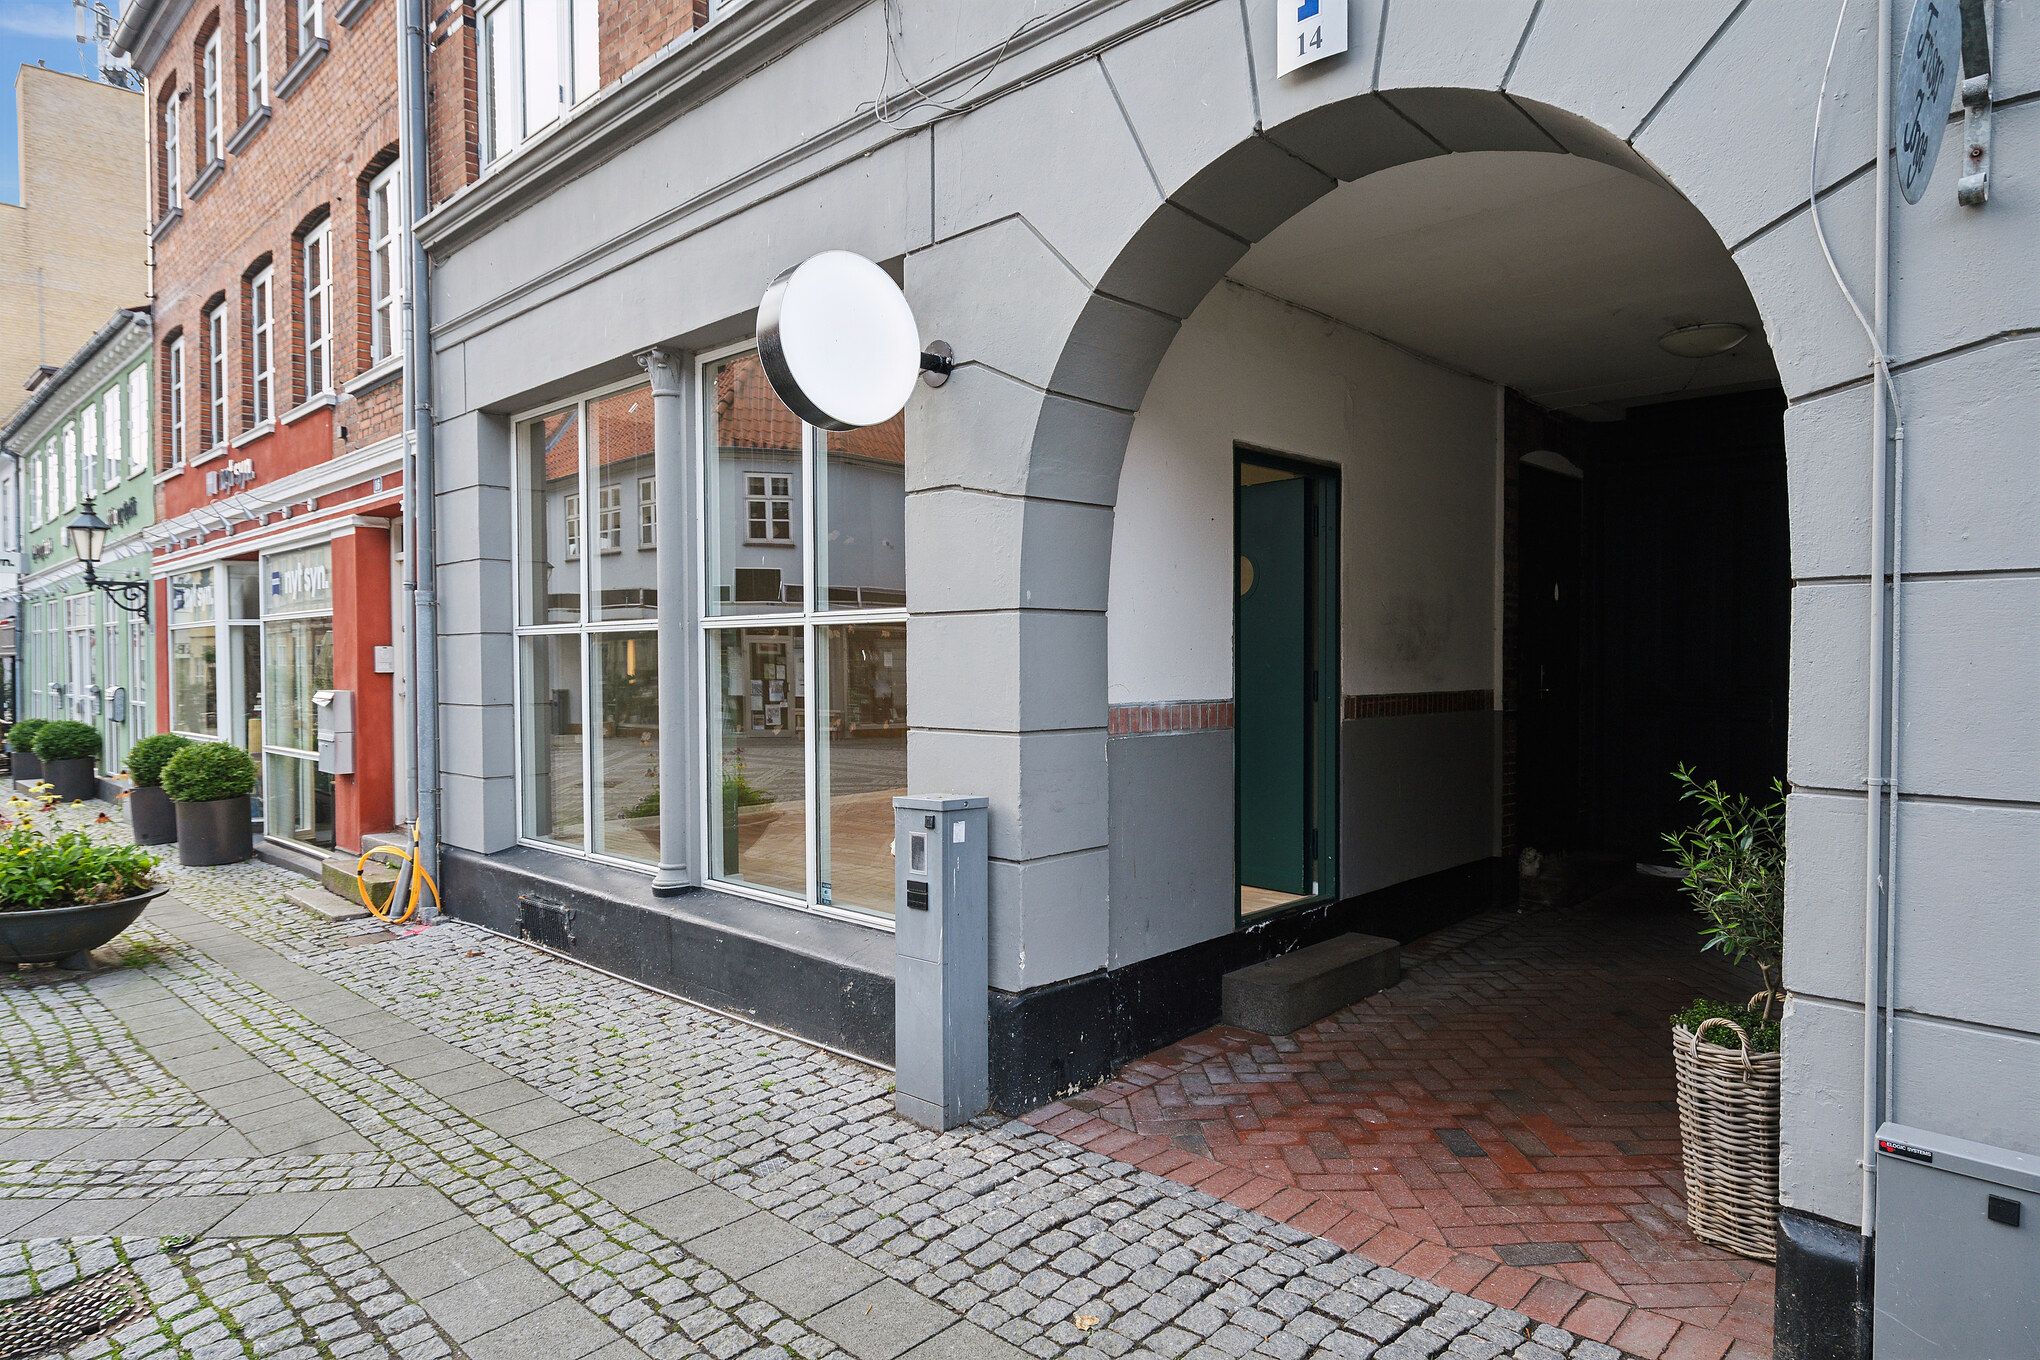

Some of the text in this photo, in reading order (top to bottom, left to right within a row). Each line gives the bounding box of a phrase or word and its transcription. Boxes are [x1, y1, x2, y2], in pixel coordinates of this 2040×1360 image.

[1297, 25, 1323, 57] 14
[1886, 1142, 1932, 1157] ELOGIC SYSTEMS
